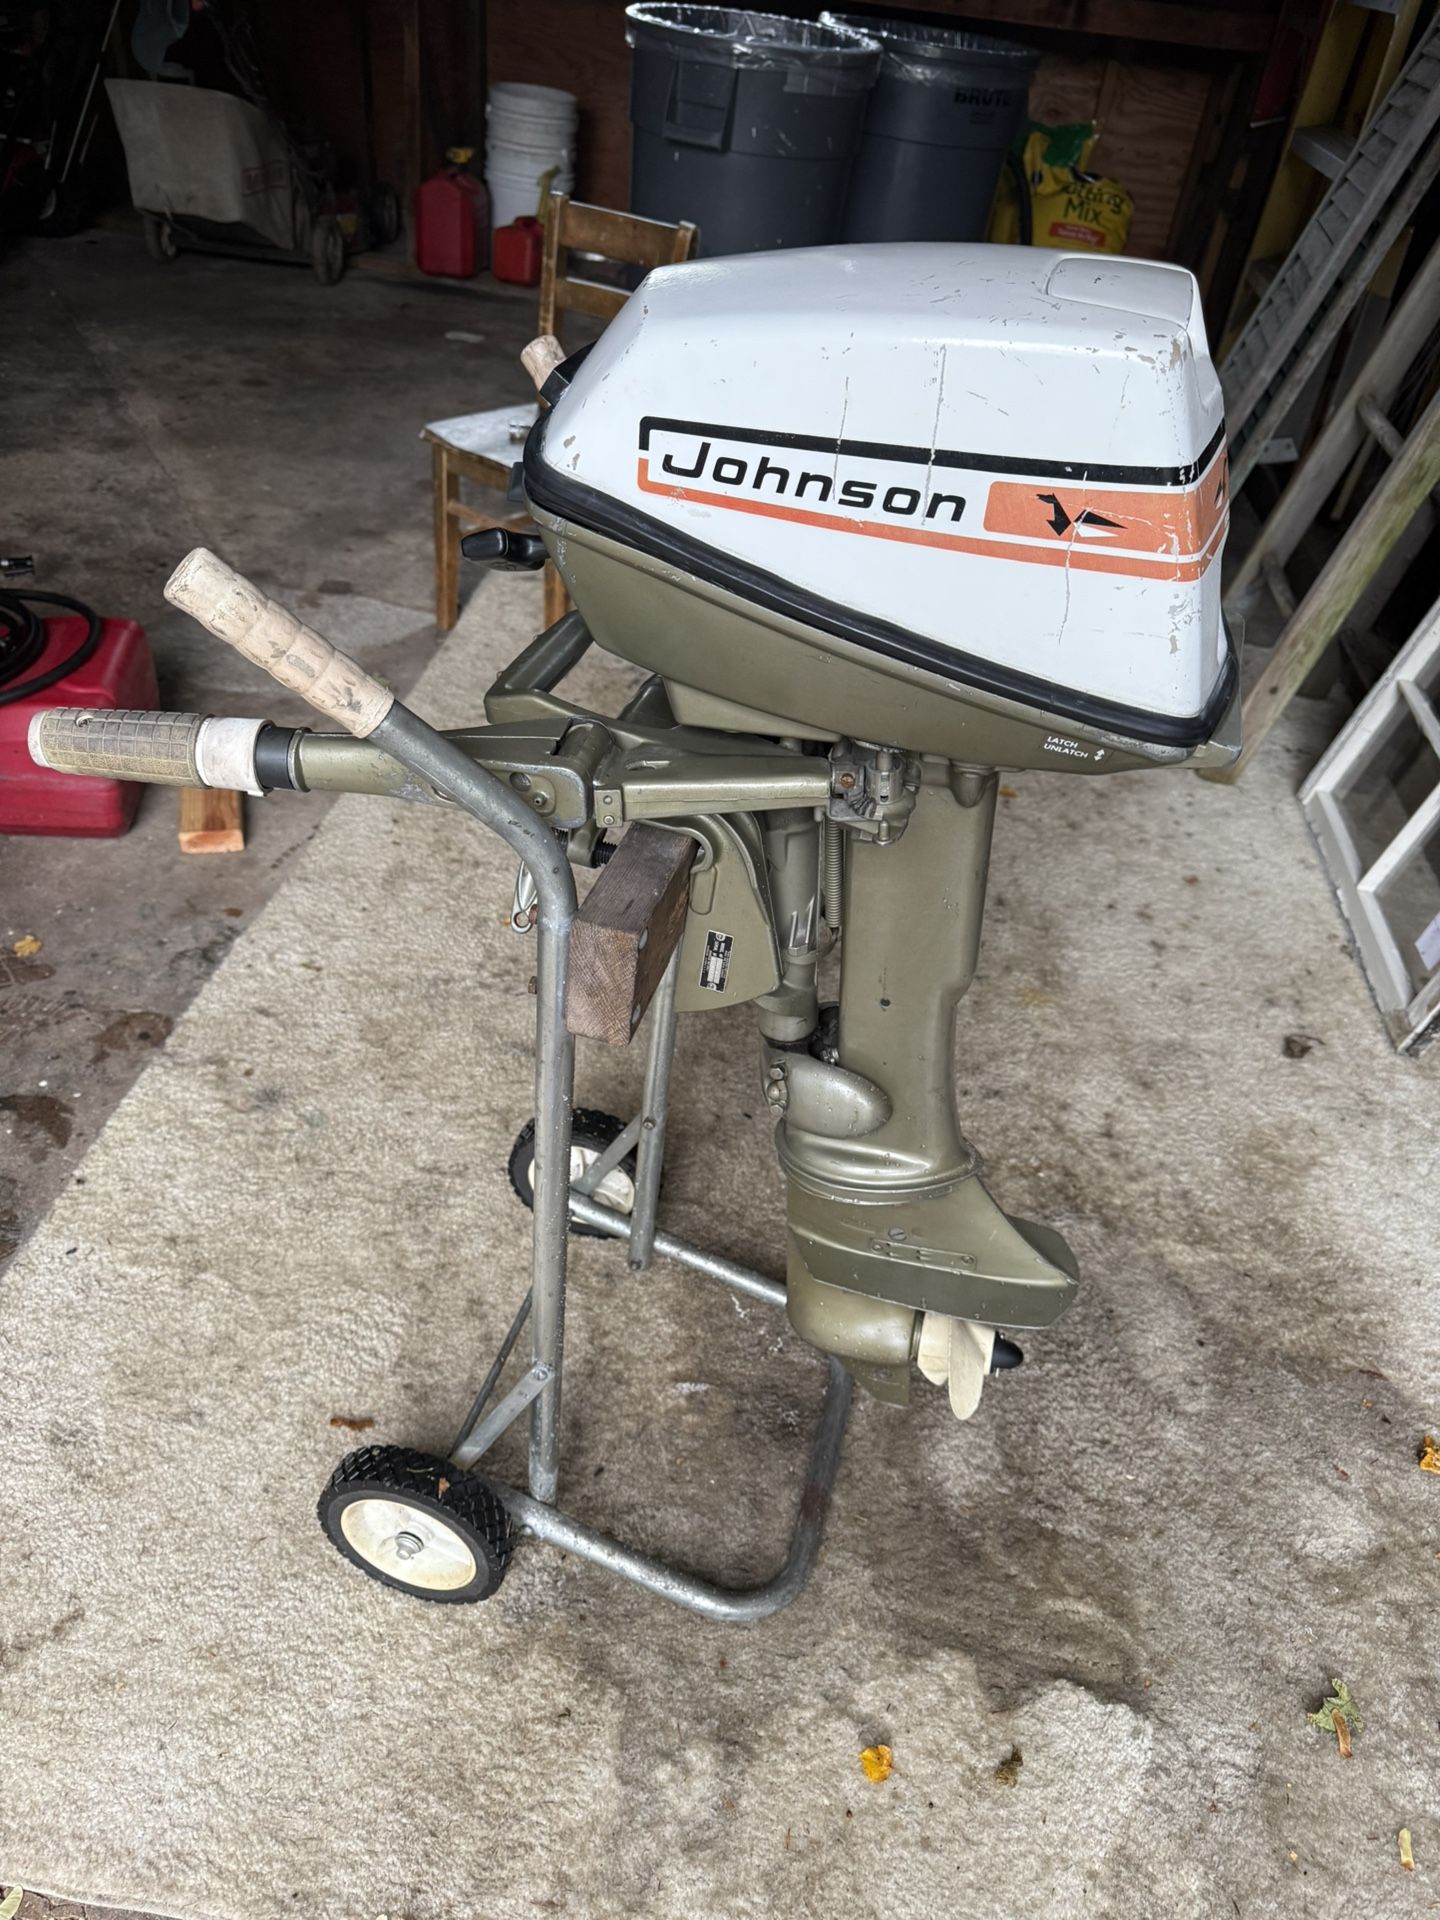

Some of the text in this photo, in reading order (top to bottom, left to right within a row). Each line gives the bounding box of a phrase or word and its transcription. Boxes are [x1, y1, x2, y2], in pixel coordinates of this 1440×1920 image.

[1061, 182, 1125, 215] otting
[1064, 197, 1102, 225] Mix
[661, 441, 967, 522] Johnson
[1043, 743, 1089, 758] UNLATCH
[1047, 736, 1079, 749] LATCH
